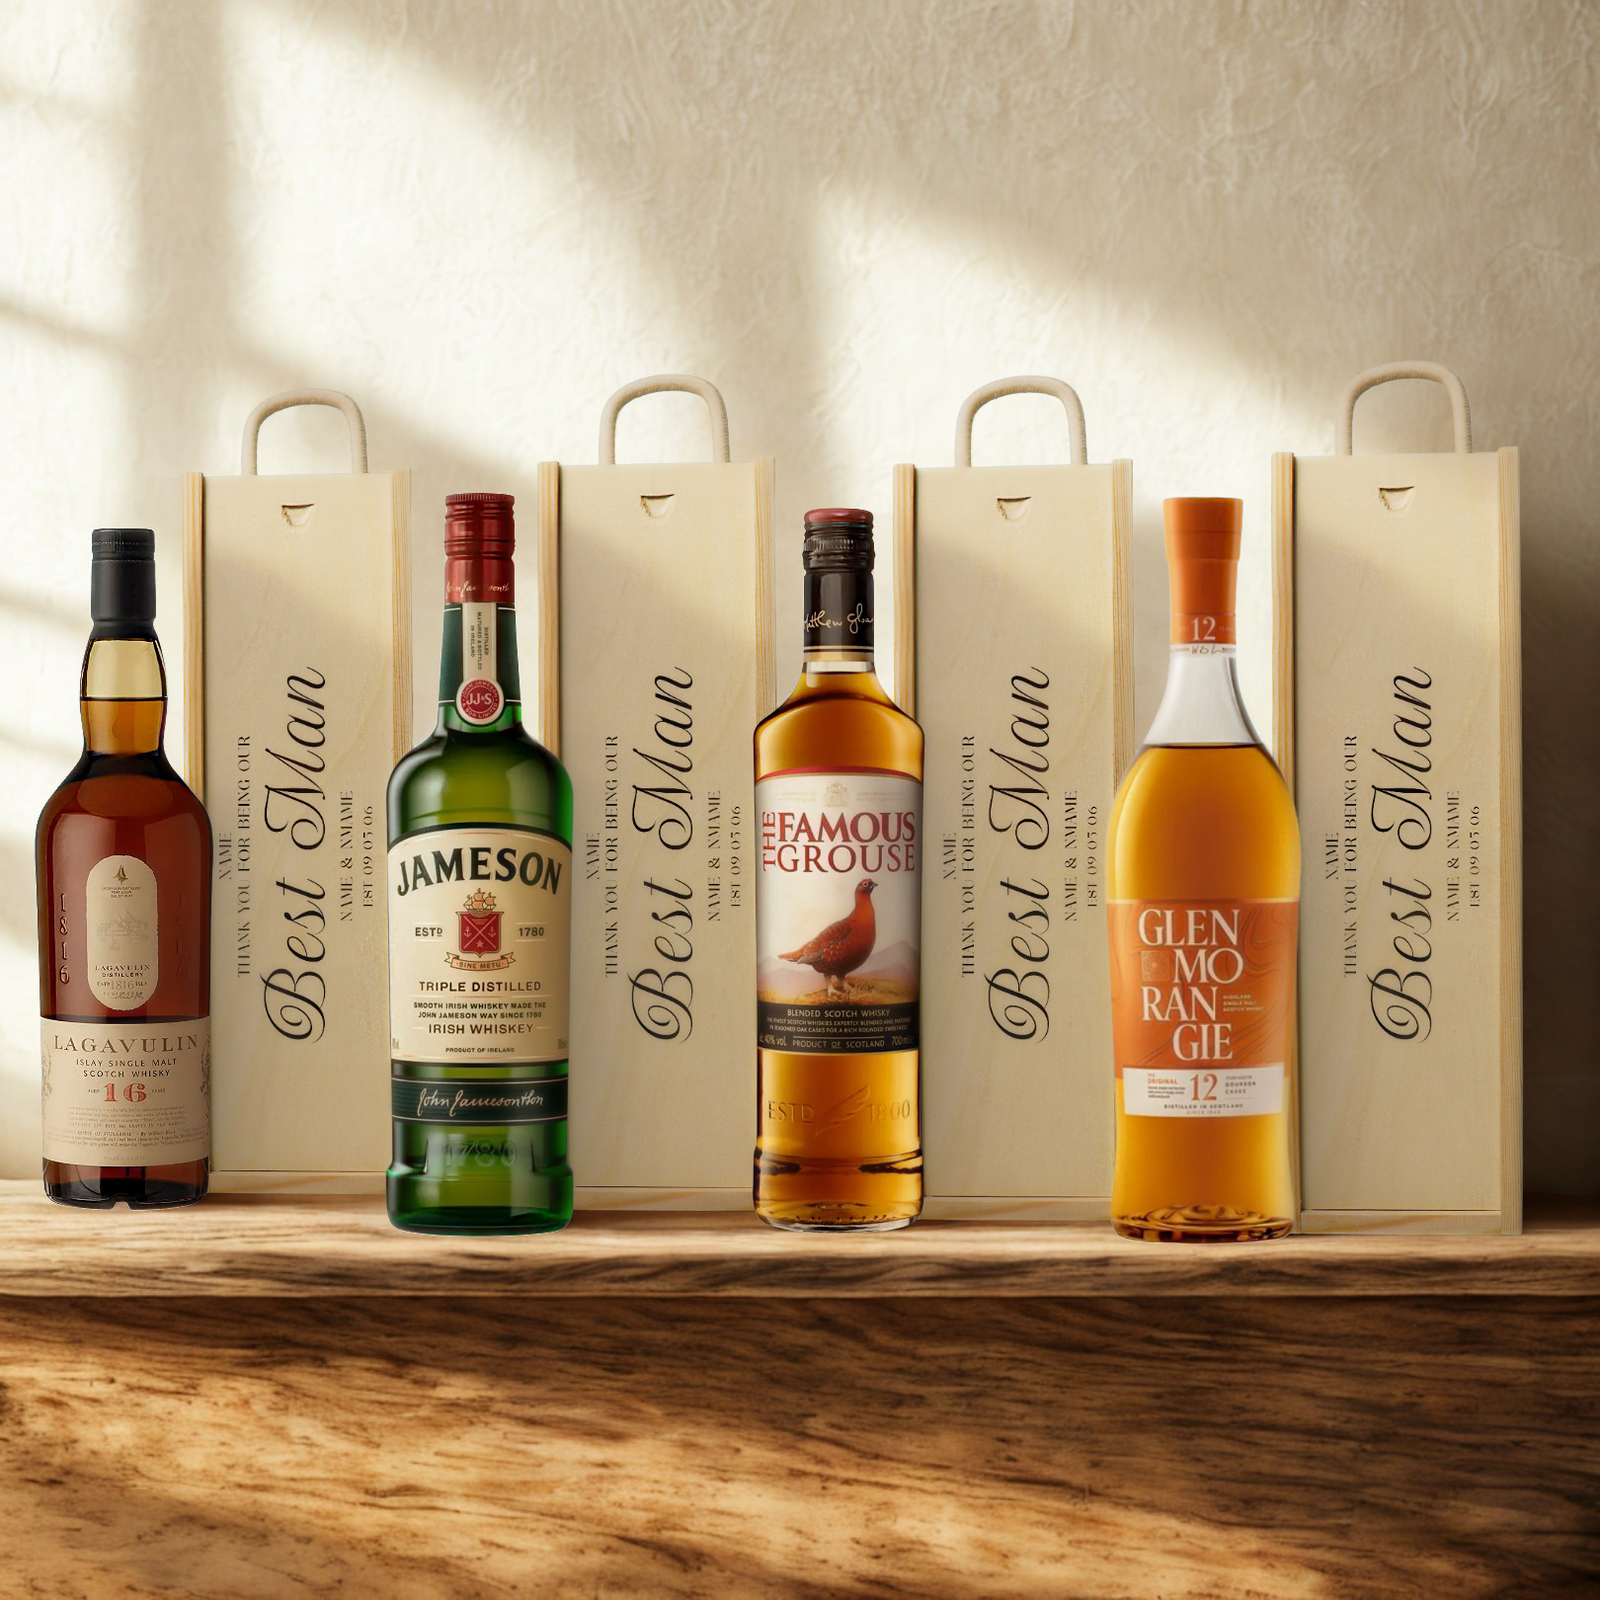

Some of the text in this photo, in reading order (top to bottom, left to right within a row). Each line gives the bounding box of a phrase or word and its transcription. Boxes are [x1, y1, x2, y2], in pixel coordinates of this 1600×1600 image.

[1191, 616, 1216, 641] 12
[762, 811, 776, 871] THE
[778, 812, 915, 843] FAMOUS
[218, 833, 232, 880] NAME
[238, 736, 250, 978] THANK YOU FOR BEING OUR
[260, 666, 326, 1044] Best Man
[340, 857, 353, 869] &
[586, 833, 599, 880] NAME
[605, 736, 618, 978] THANK YOU FOR BEING OUR
[627, 666, 693, 1044] Best Man
[707, 857, 720, 869] &
[777, 844, 915, 873] GROUSE
[942, 833, 956, 880] NAME
[962, 736, 974, 978] THANK YOU FOR BEING OUR
[984, 666, 1050, 1044] Best Man
[1064, 857, 1077, 869] &
[1325, 833, 1339, 880] NAME
[1344, 736, 1357, 978] THANK YOU FOR BEING OUR
[1367, 666, 1432, 1044] Best Man
[1447, 857, 1460, 869] &
[397, 847, 563, 897] JAMESON
[340, 877, 353, 922] NAME
[362, 882, 374, 907] EST
[707, 877, 720, 922] NAME
[730, 882, 741, 907] EST
[1064, 877, 1077, 922] NAME
[1086, 882, 1098, 907] EST
[1447, 877, 1460, 922] NAME
[1469, 882, 1480, 907] EST
[518, 927, 544, 937] 1780
[1138, 908, 1240, 946] GLEN
[459, 961, 501, 969] SINE METU
[1173, 947, 1245, 984] MO
[419, 981, 541, 992] TRIPLE DISTILLED
[413, 1001, 443, 1009] SMOOTH
[787, 1008, 890, 1018] BLENDED SCOTCH WHISKY
[1140, 986, 1218, 1021] RAN
[54, 1034, 198, 1053] LAGAVULIN
[428, 1024, 534, 1034] IRISH WHISKEY
[1172, 1023, 1233, 1061] GIE
[792, 1040, 827, 1048] PRODUCT
[846, 1040, 885, 1048] SCOTLAND
[76, 1058, 177, 1068] ISLAY SINGLE MALT
[83, 1070, 171, 1078] SCOTCH WHISKY
[103, 1082, 147, 1102] 16
[1189, 1073, 1218, 1101] 12
[417, 1088, 449, 1116] John
[868, 1100, 911, 1122] 1800
